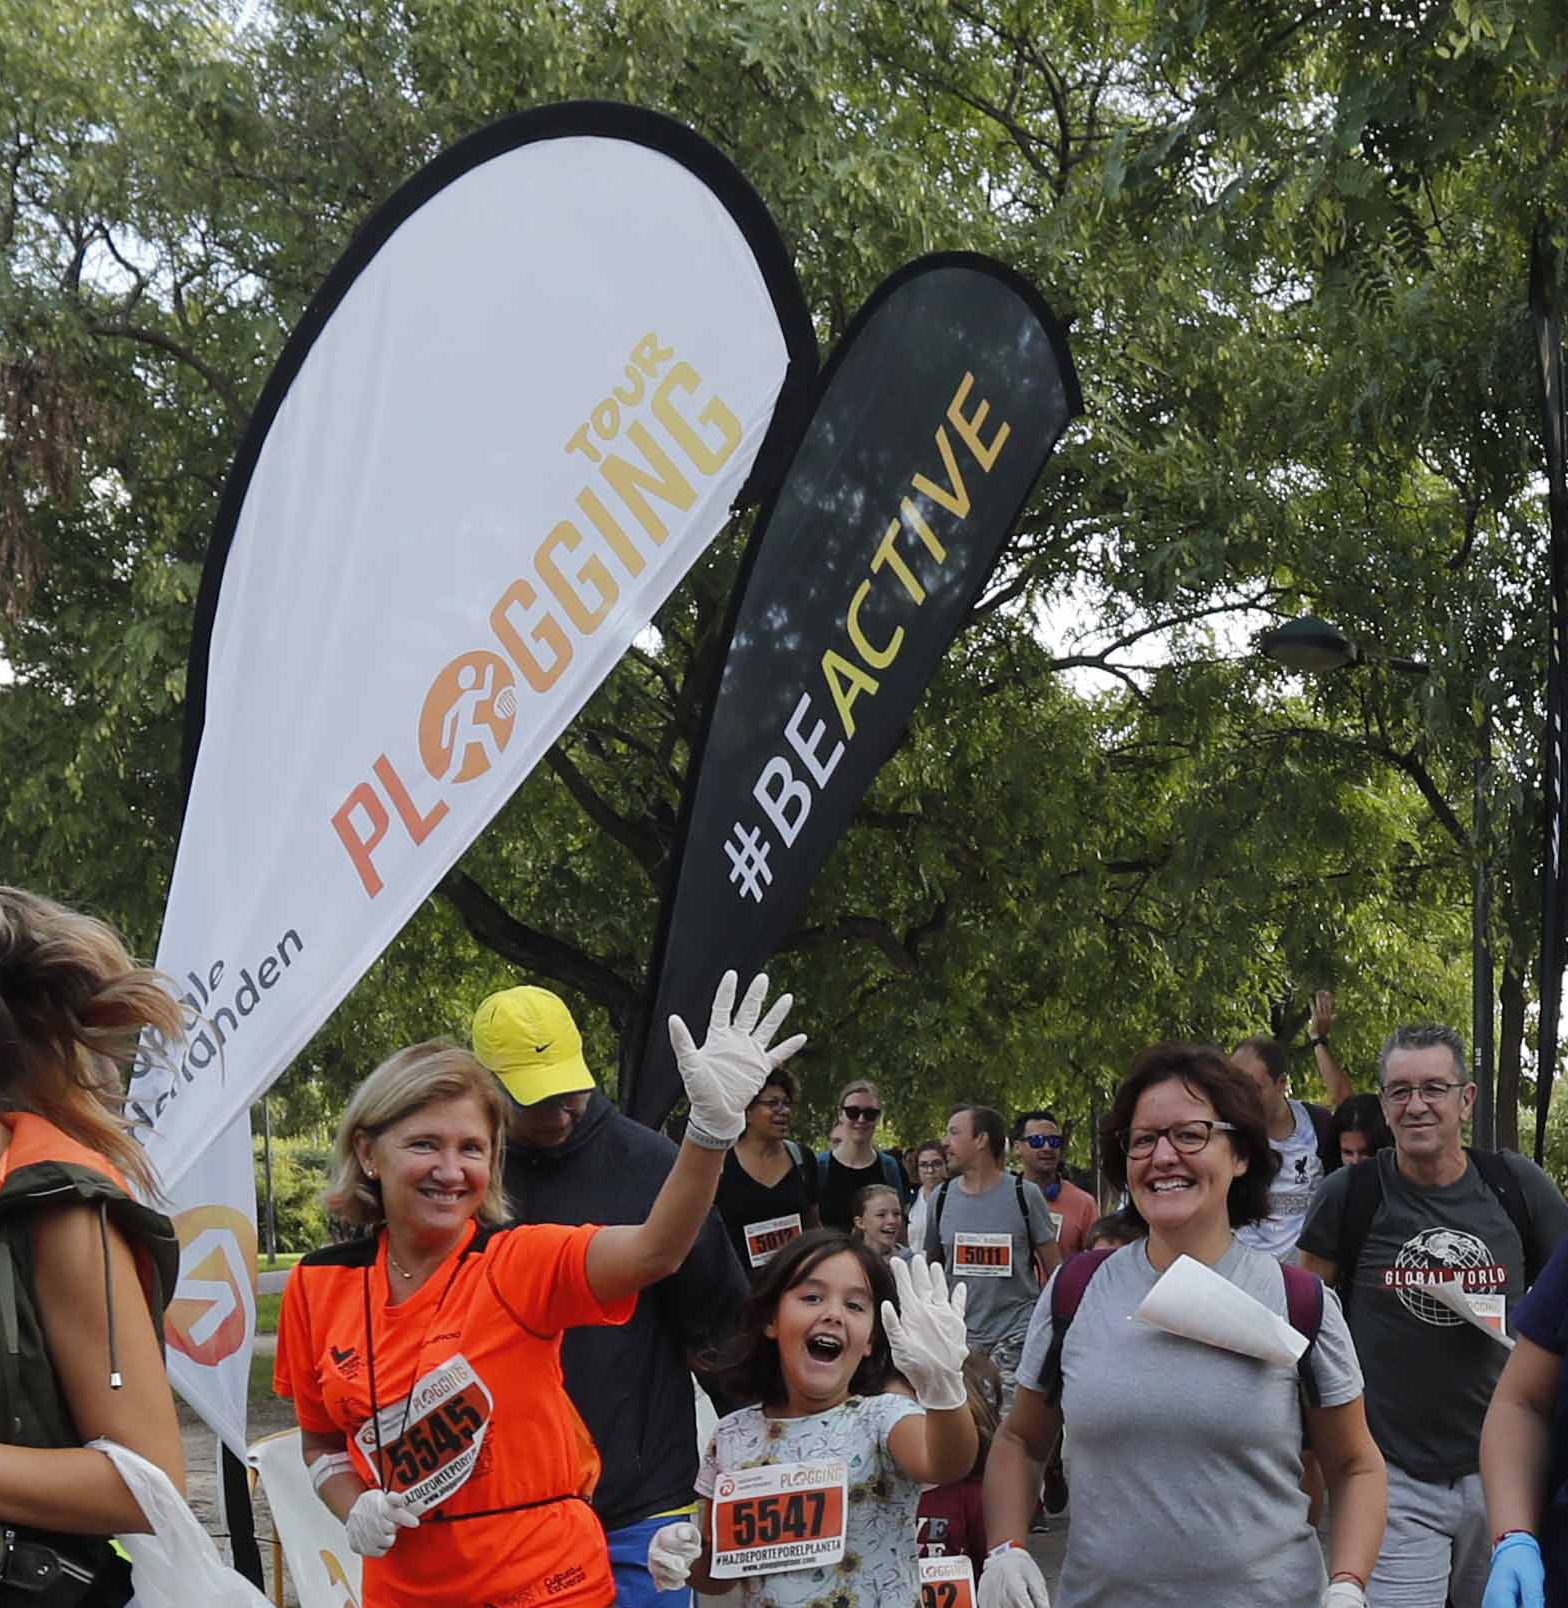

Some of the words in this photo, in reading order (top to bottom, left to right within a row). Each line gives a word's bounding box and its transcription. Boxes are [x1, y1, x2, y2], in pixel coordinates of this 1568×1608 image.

[565, 332, 673, 463] TOUR
[330, 361, 742, 899] PLOGGING
[723, 372, 1010, 903] #BEACTIVE
[1384, 1270, 1444, 1286] GLOBAL
[1453, 1267, 1506, 1286] WORLD
[388, 1396, 482, 1486] 5545
[716, 1540, 841, 1566] #HAZDEPORTEPORELPLANETA
[733, 1492, 826, 1546] 5547
